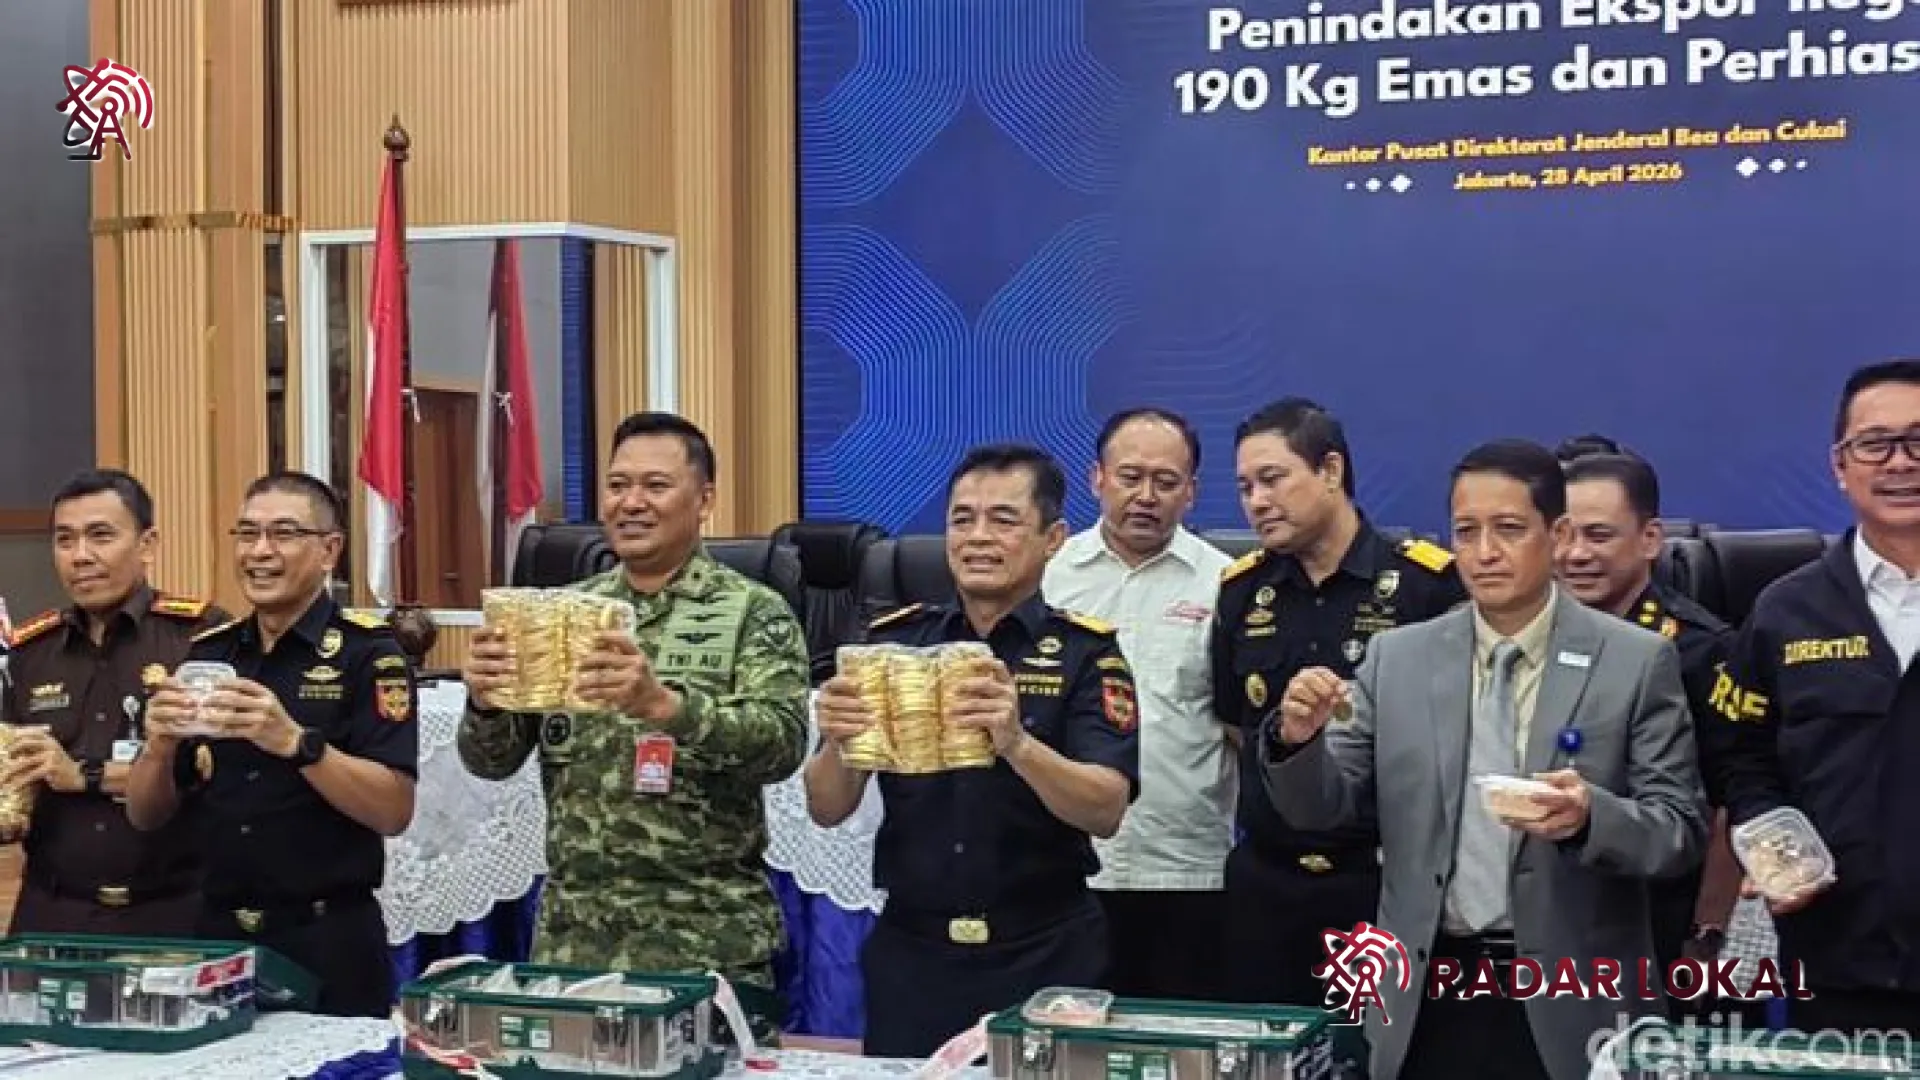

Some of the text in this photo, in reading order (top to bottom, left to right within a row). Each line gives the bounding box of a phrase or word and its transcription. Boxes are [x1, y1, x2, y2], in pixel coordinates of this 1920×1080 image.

[1208, 0, 1541, 51] Penindakan
[1173, 30, 1920, 118] 190 Kg Emas dan Perhias
[1308, 118, 1847, 165] Kantor Pusat Direktorat Jenderal Bea dan Cukai
[1454, 161, 1684, 190] Jakarta, 28 April 2026
